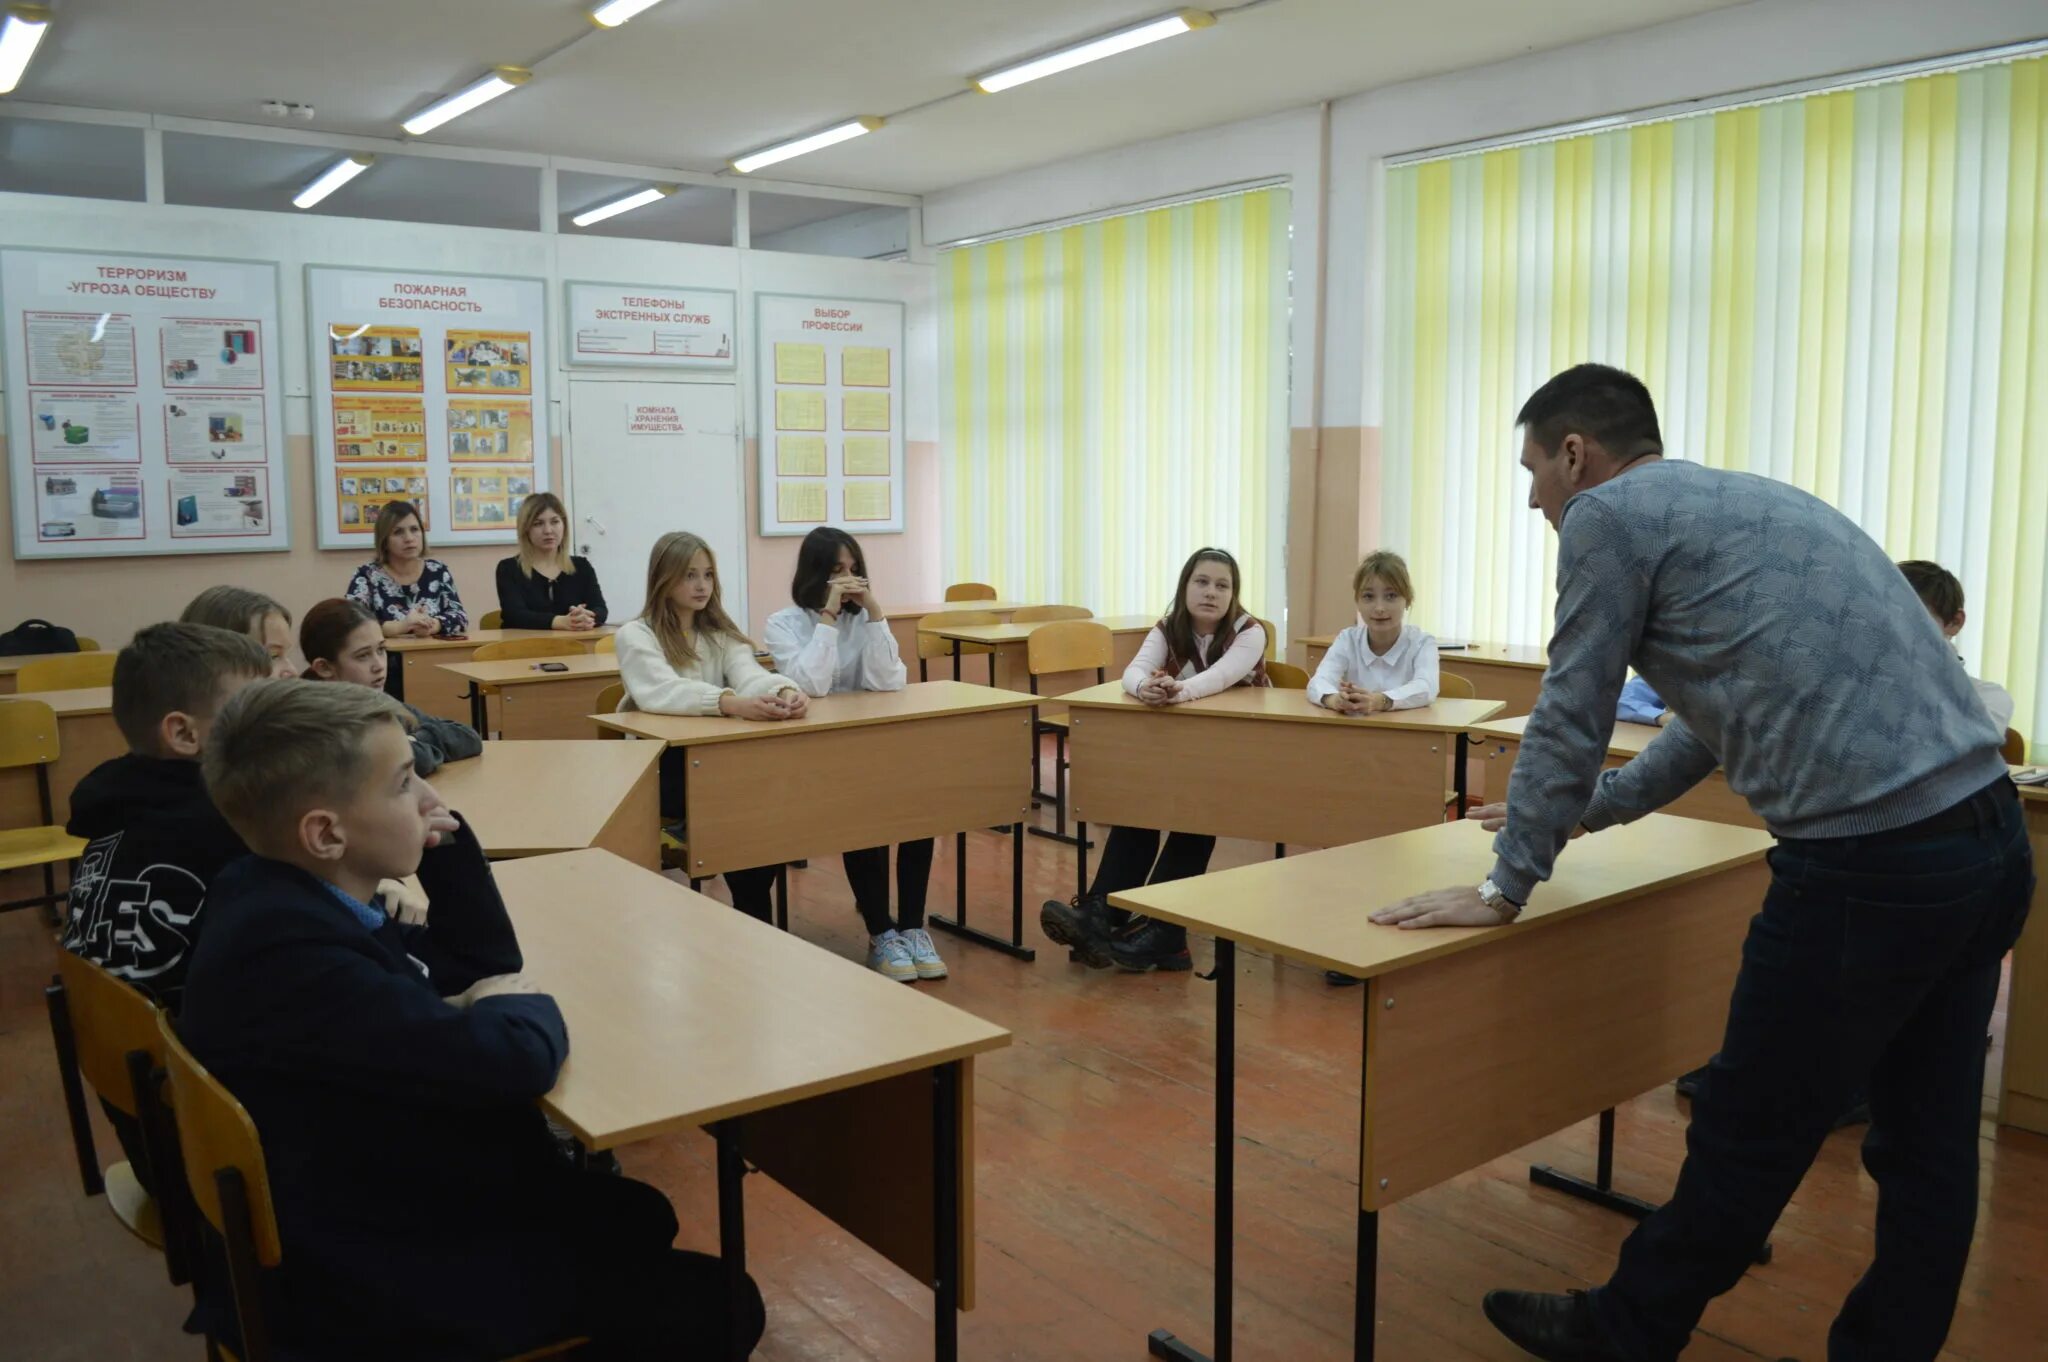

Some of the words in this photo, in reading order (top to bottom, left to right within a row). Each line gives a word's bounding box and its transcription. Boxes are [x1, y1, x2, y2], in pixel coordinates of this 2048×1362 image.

[96, 266, 187, 282] ТЕРРОРИЗМ
[134, 284, 217, 299] ОБЩЕСТВУ
[394, 283, 467, 297] ПОЖАРНАЯ
[378, 297, 483, 313] БЕЗОПАСНОСТЬ
[622, 296, 686, 310] ТЕЛЕФОНЫ
[595, 309, 671, 323] ЭКСТРЕННЫХ
[673, 312, 712, 325] СЛУЖБ
[814, 308, 851, 319] ВЫБОР
[802, 320, 863, 332] ПРОФЕССИИ
[637, 406, 677, 415] КОМНАТА
[635, 414, 680, 423] ХРАНЕНИЯ
[630, 423, 685, 432] ИМУЩЕСТВА
